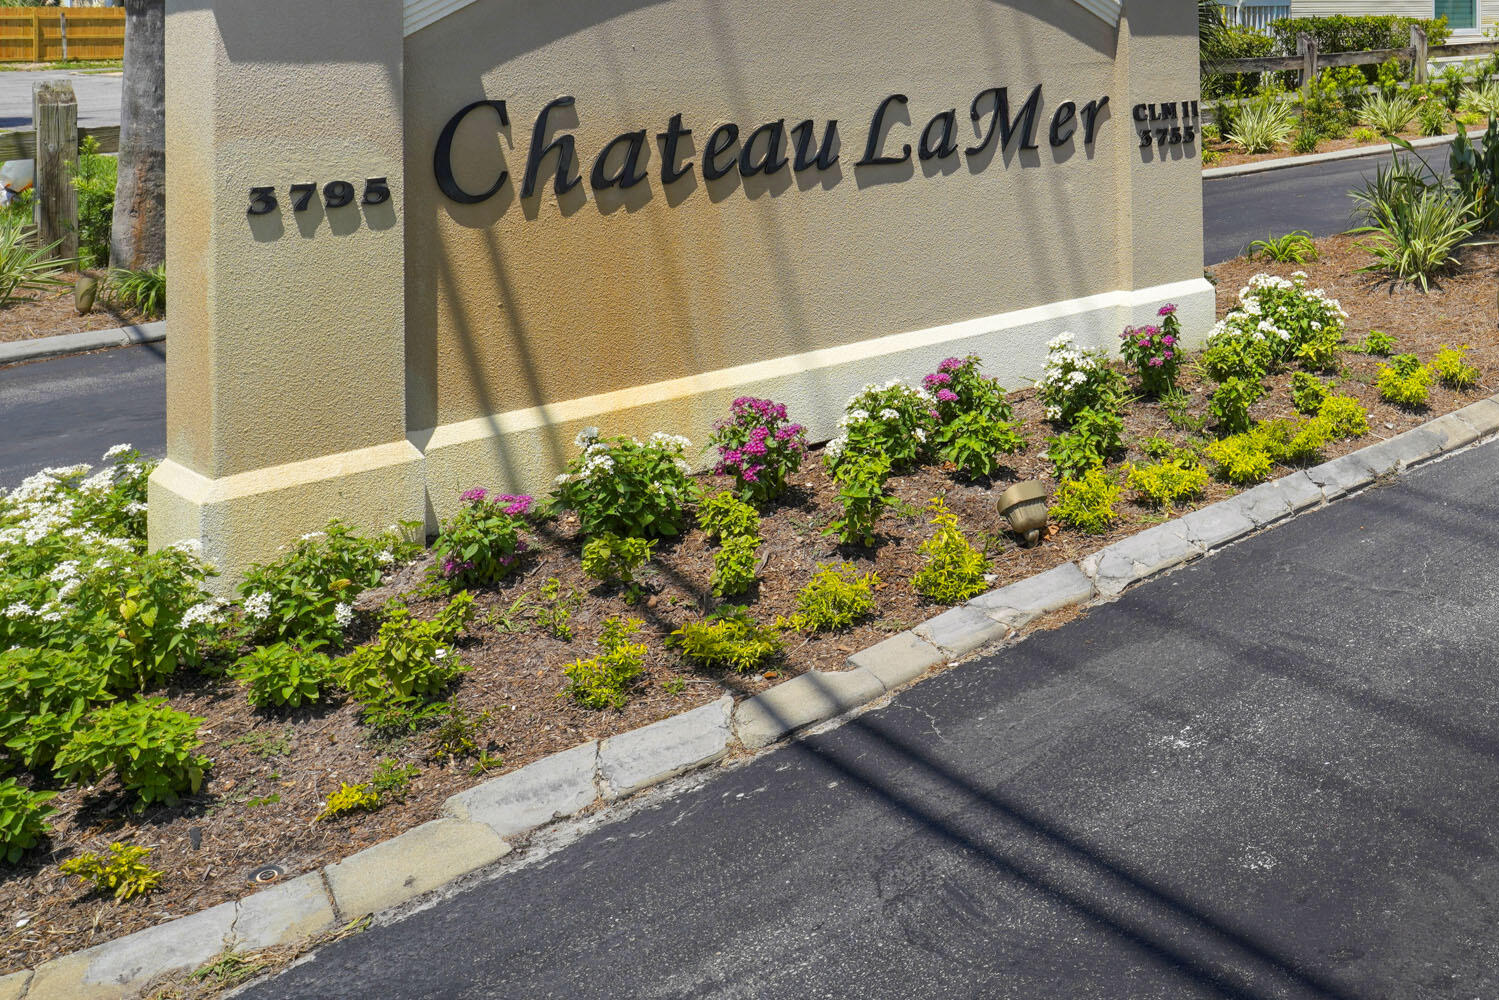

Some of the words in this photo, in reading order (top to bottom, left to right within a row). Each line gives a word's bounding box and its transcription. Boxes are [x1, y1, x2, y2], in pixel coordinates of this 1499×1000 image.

[1132, 102, 1178, 121] CLM
[433, 95, 839, 204] Chateau
[247, 177, 391, 215] 3795
